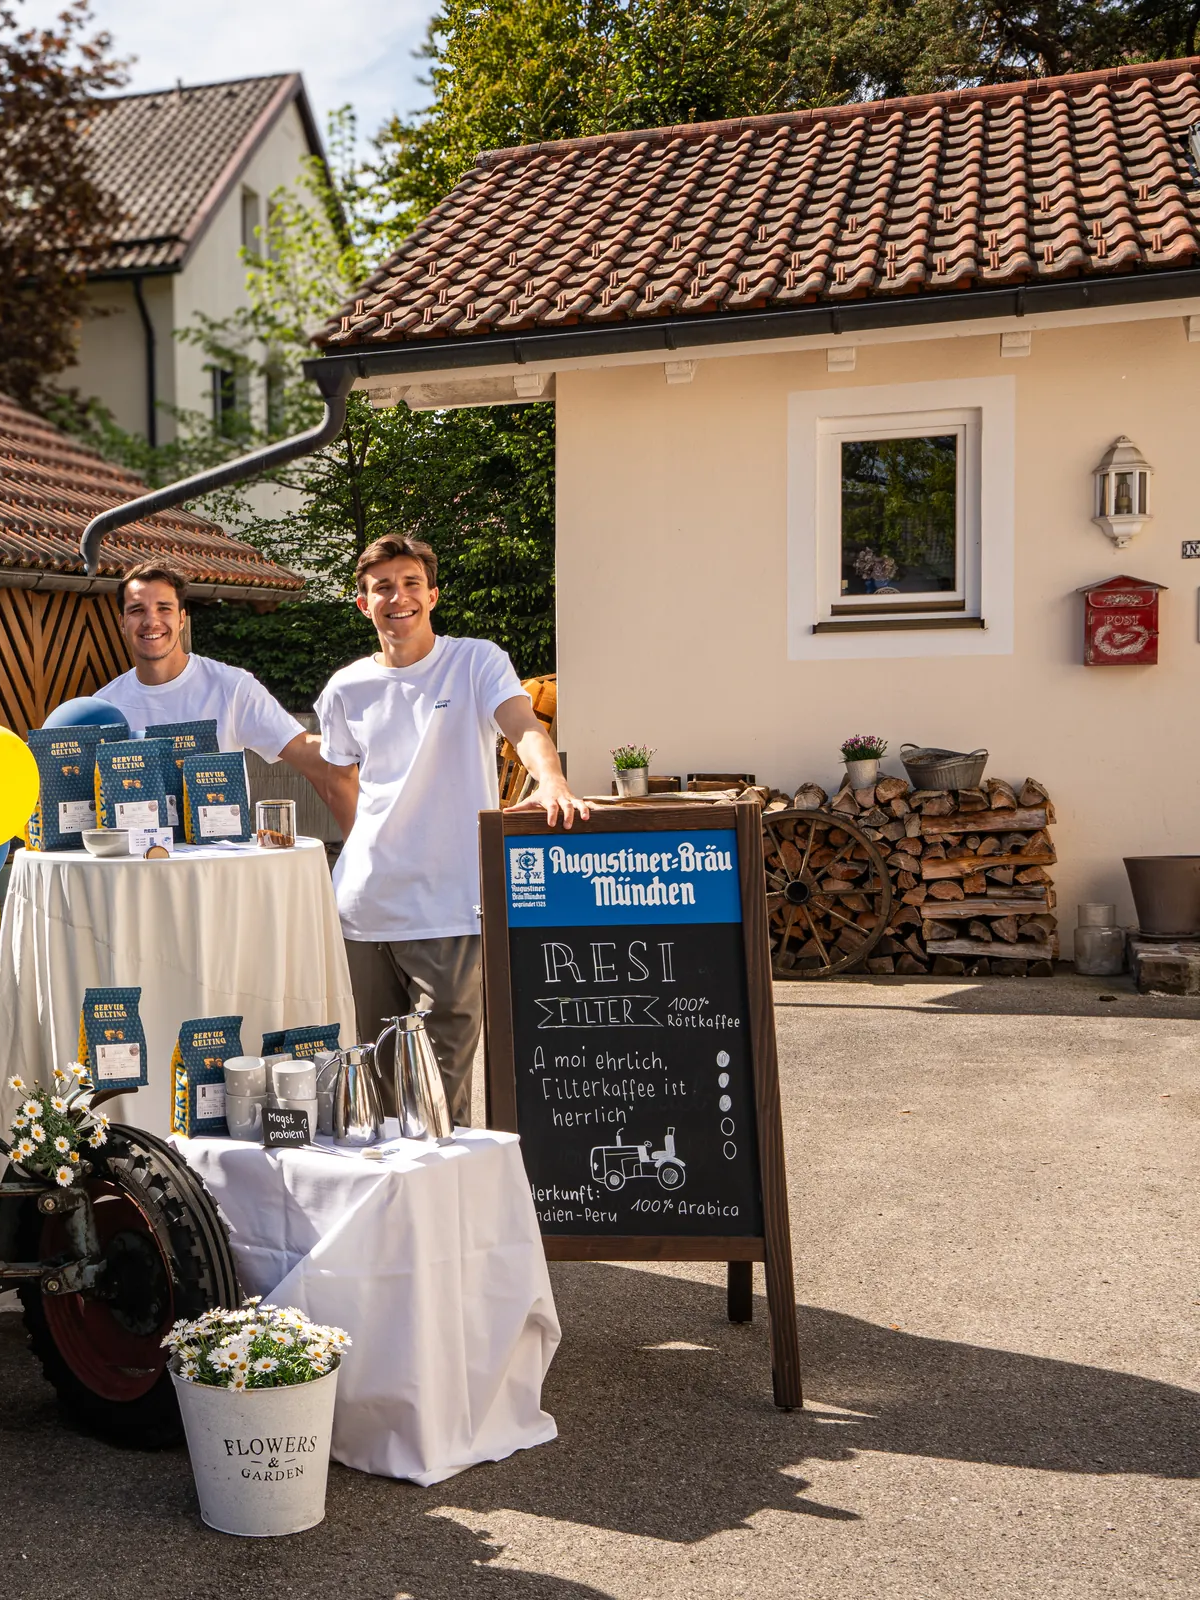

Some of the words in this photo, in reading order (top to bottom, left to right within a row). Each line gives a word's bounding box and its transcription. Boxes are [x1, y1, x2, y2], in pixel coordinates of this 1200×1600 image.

[1104, 615, 1140, 626] POST
[51, 741, 79, 749] SERVUS
[51, 747, 81, 756] GELTING
[112, 755, 143, 763] SERVUS
[112, 761, 145, 770] GELTING
[591, 876, 696, 906] München
[541, 940, 676, 983] RESI
[94, 1003, 125, 1011] SERVUS
[667, 997, 710, 1012] 100%
[93, 1010, 128, 1018] GELTING
[559, 999, 634, 1024] FILTER
[667, 1013, 740, 1029] Röstkaffee
[193, 1030, 224, 1040] SERVUS
[192, 1037, 227, 1047] GELTING
[294, 1040, 325, 1051] SERVUS
[542, 1077, 656, 1101] Filterkaffee
[664, 1078, 687, 1096] ist
[268, 1113, 295, 1129] Mogst
[630, 1199, 674, 1213] 100%
[678, 1200, 740, 1217] Arabica
[224, 1436, 317, 1456] FLOWERS
[241, 1465, 304, 1482] GARDEN
